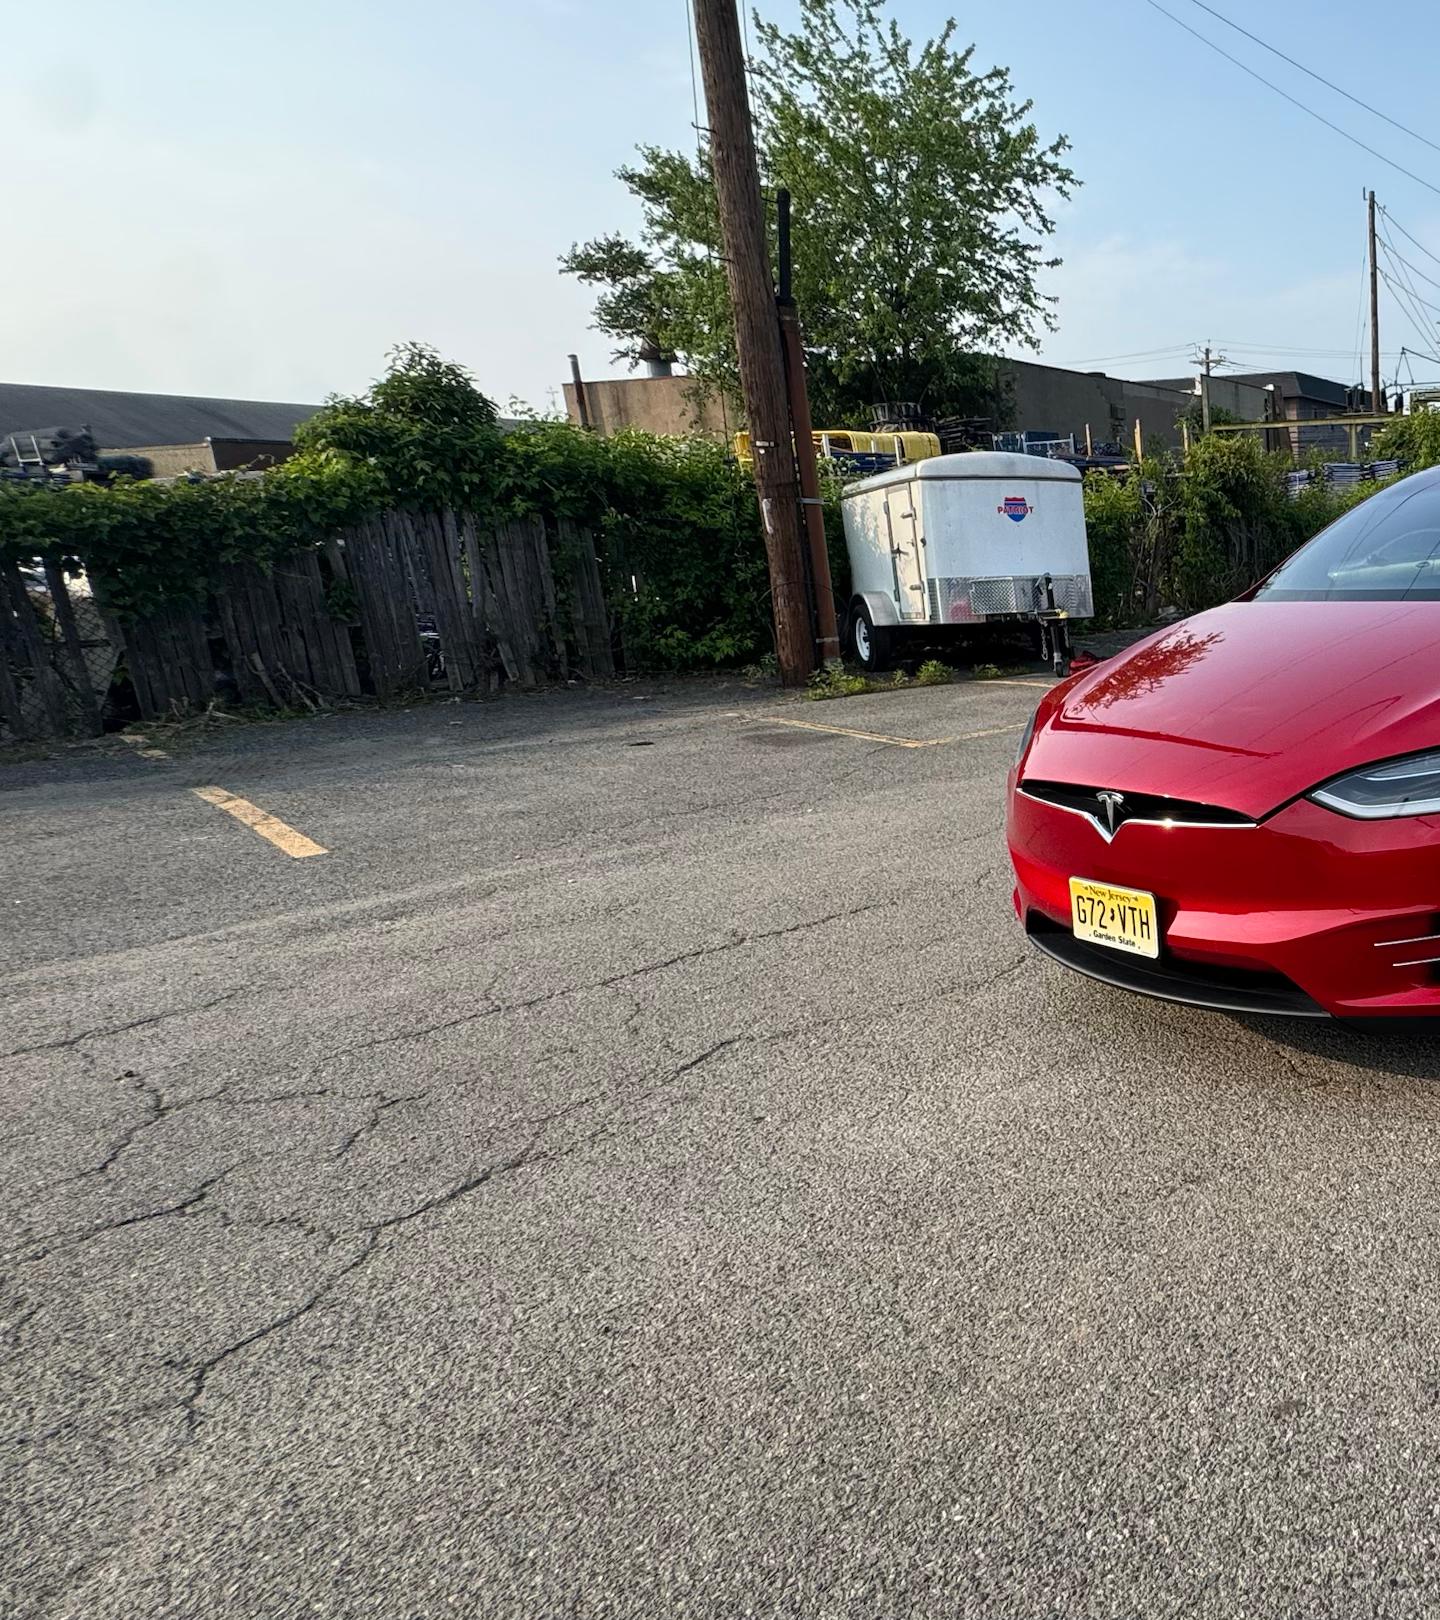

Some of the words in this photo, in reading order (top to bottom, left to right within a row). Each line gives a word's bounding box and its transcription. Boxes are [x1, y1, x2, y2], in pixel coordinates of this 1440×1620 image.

[997, 506, 1034, 514] PATRIOT
[1088, 885, 1106, 897] New
[1108, 890, 1132, 904] Jersey
[1093, 930, 1116, 943] Garden
[1119, 936, 1136, 948] State
